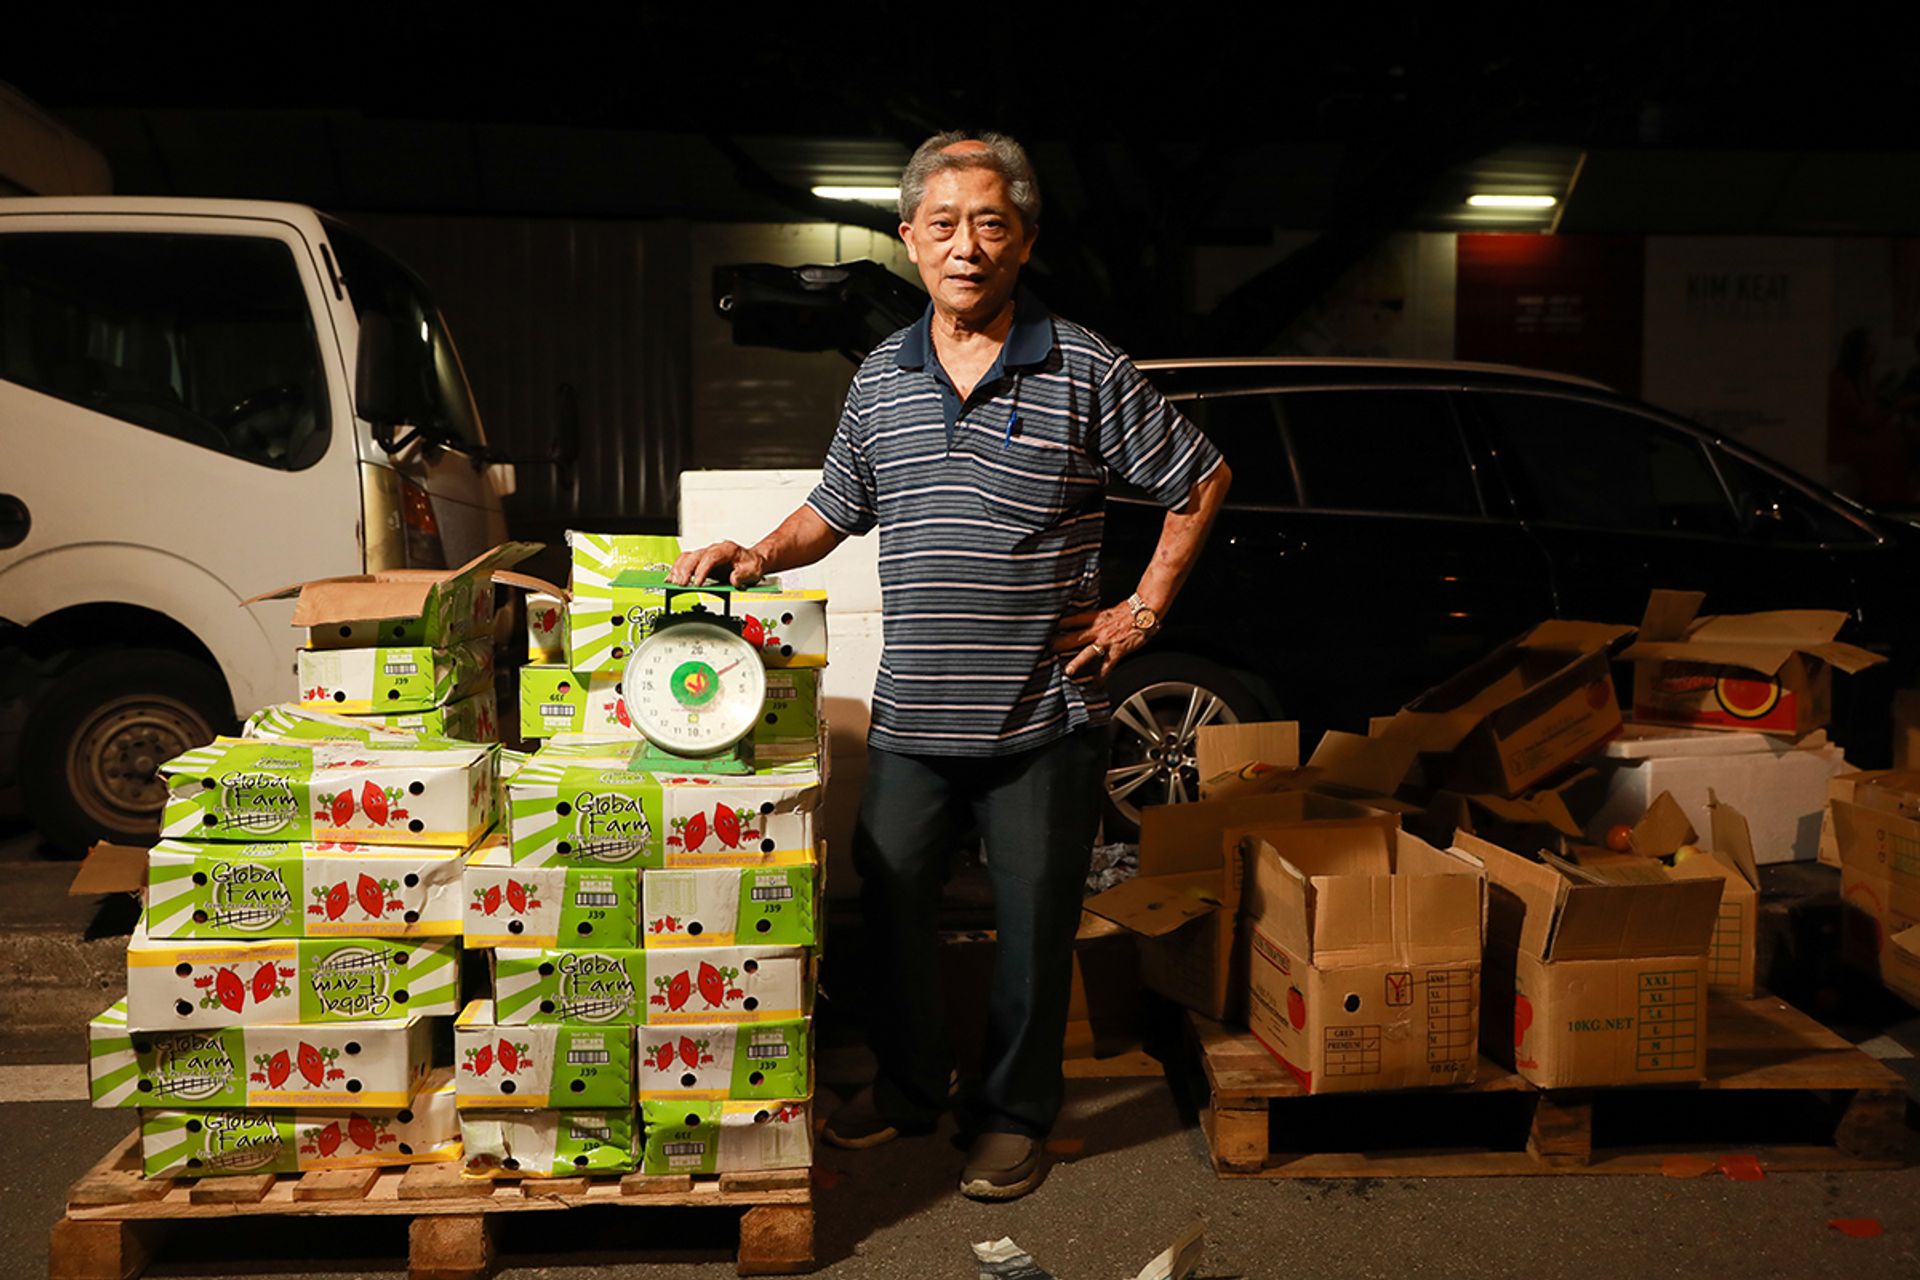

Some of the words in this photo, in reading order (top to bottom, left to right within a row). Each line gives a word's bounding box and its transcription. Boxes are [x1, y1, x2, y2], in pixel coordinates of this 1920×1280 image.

[1686, 273, 1728, 301] KIM
[691, 645, 704, 655] 20
[394, 677, 409, 685] J39
[687, 727, 699, 736] 10
[220, 771, 290, 790] Global
[235, 787, 299, 807] Farm
[575, 791, 644, 815] Global
[589, 813, 652, 833] Farm
[211, 862, 283, 884] Global
[226, 882, 292, 902] Farm
[588, 910, 605, 919] J39
[764, 904, 781, 913] J39
[558, 953, 627, 975] Global
[311, 976, 376, 997] Farm
[573, 974, 635, 993] Farm
[1646, 976, 1670, 985] XXL
[320, 995, 390, 1016] Global
[1653, 1026, 1661, 1034] L
[155, 1034, 225, 1051] Global
[170, 1050, 235, 1070] Farm
[760, 1061, 777, 1070] J39
[580, 1068, 597, 1077] J39
[205, 1111, 275, 1130] Global
[219, 1129, 284, 1149] Farm
